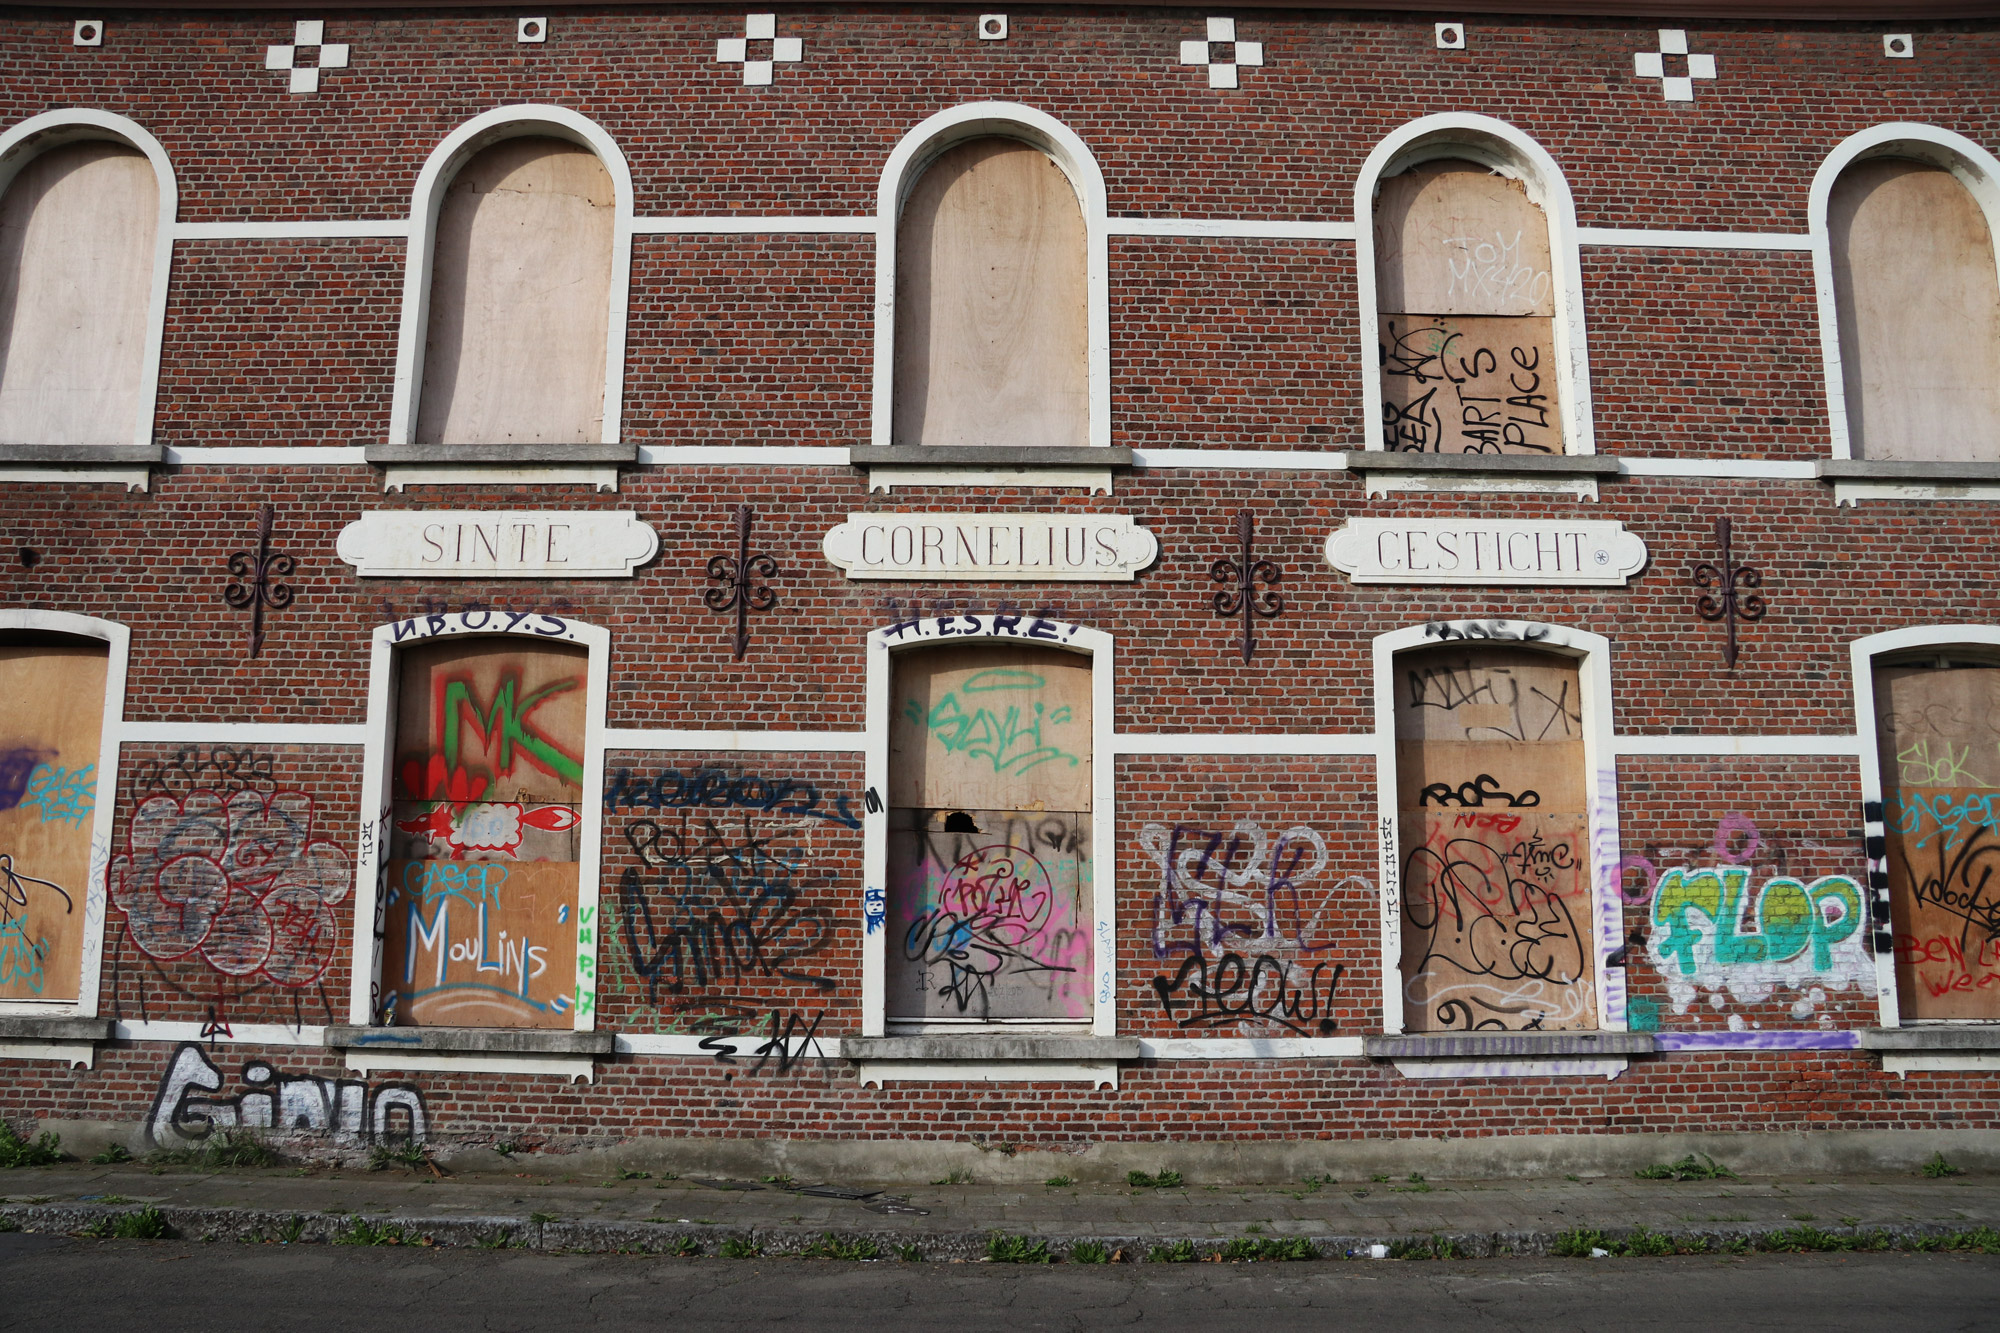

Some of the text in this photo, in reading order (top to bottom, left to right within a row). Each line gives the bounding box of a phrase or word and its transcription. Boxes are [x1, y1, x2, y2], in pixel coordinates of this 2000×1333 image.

[422, 523, 570, 563] SINTE
[862, 525, 1118, 567] CORNELIUS
[1650, 866, 1866, 976] FLOP
